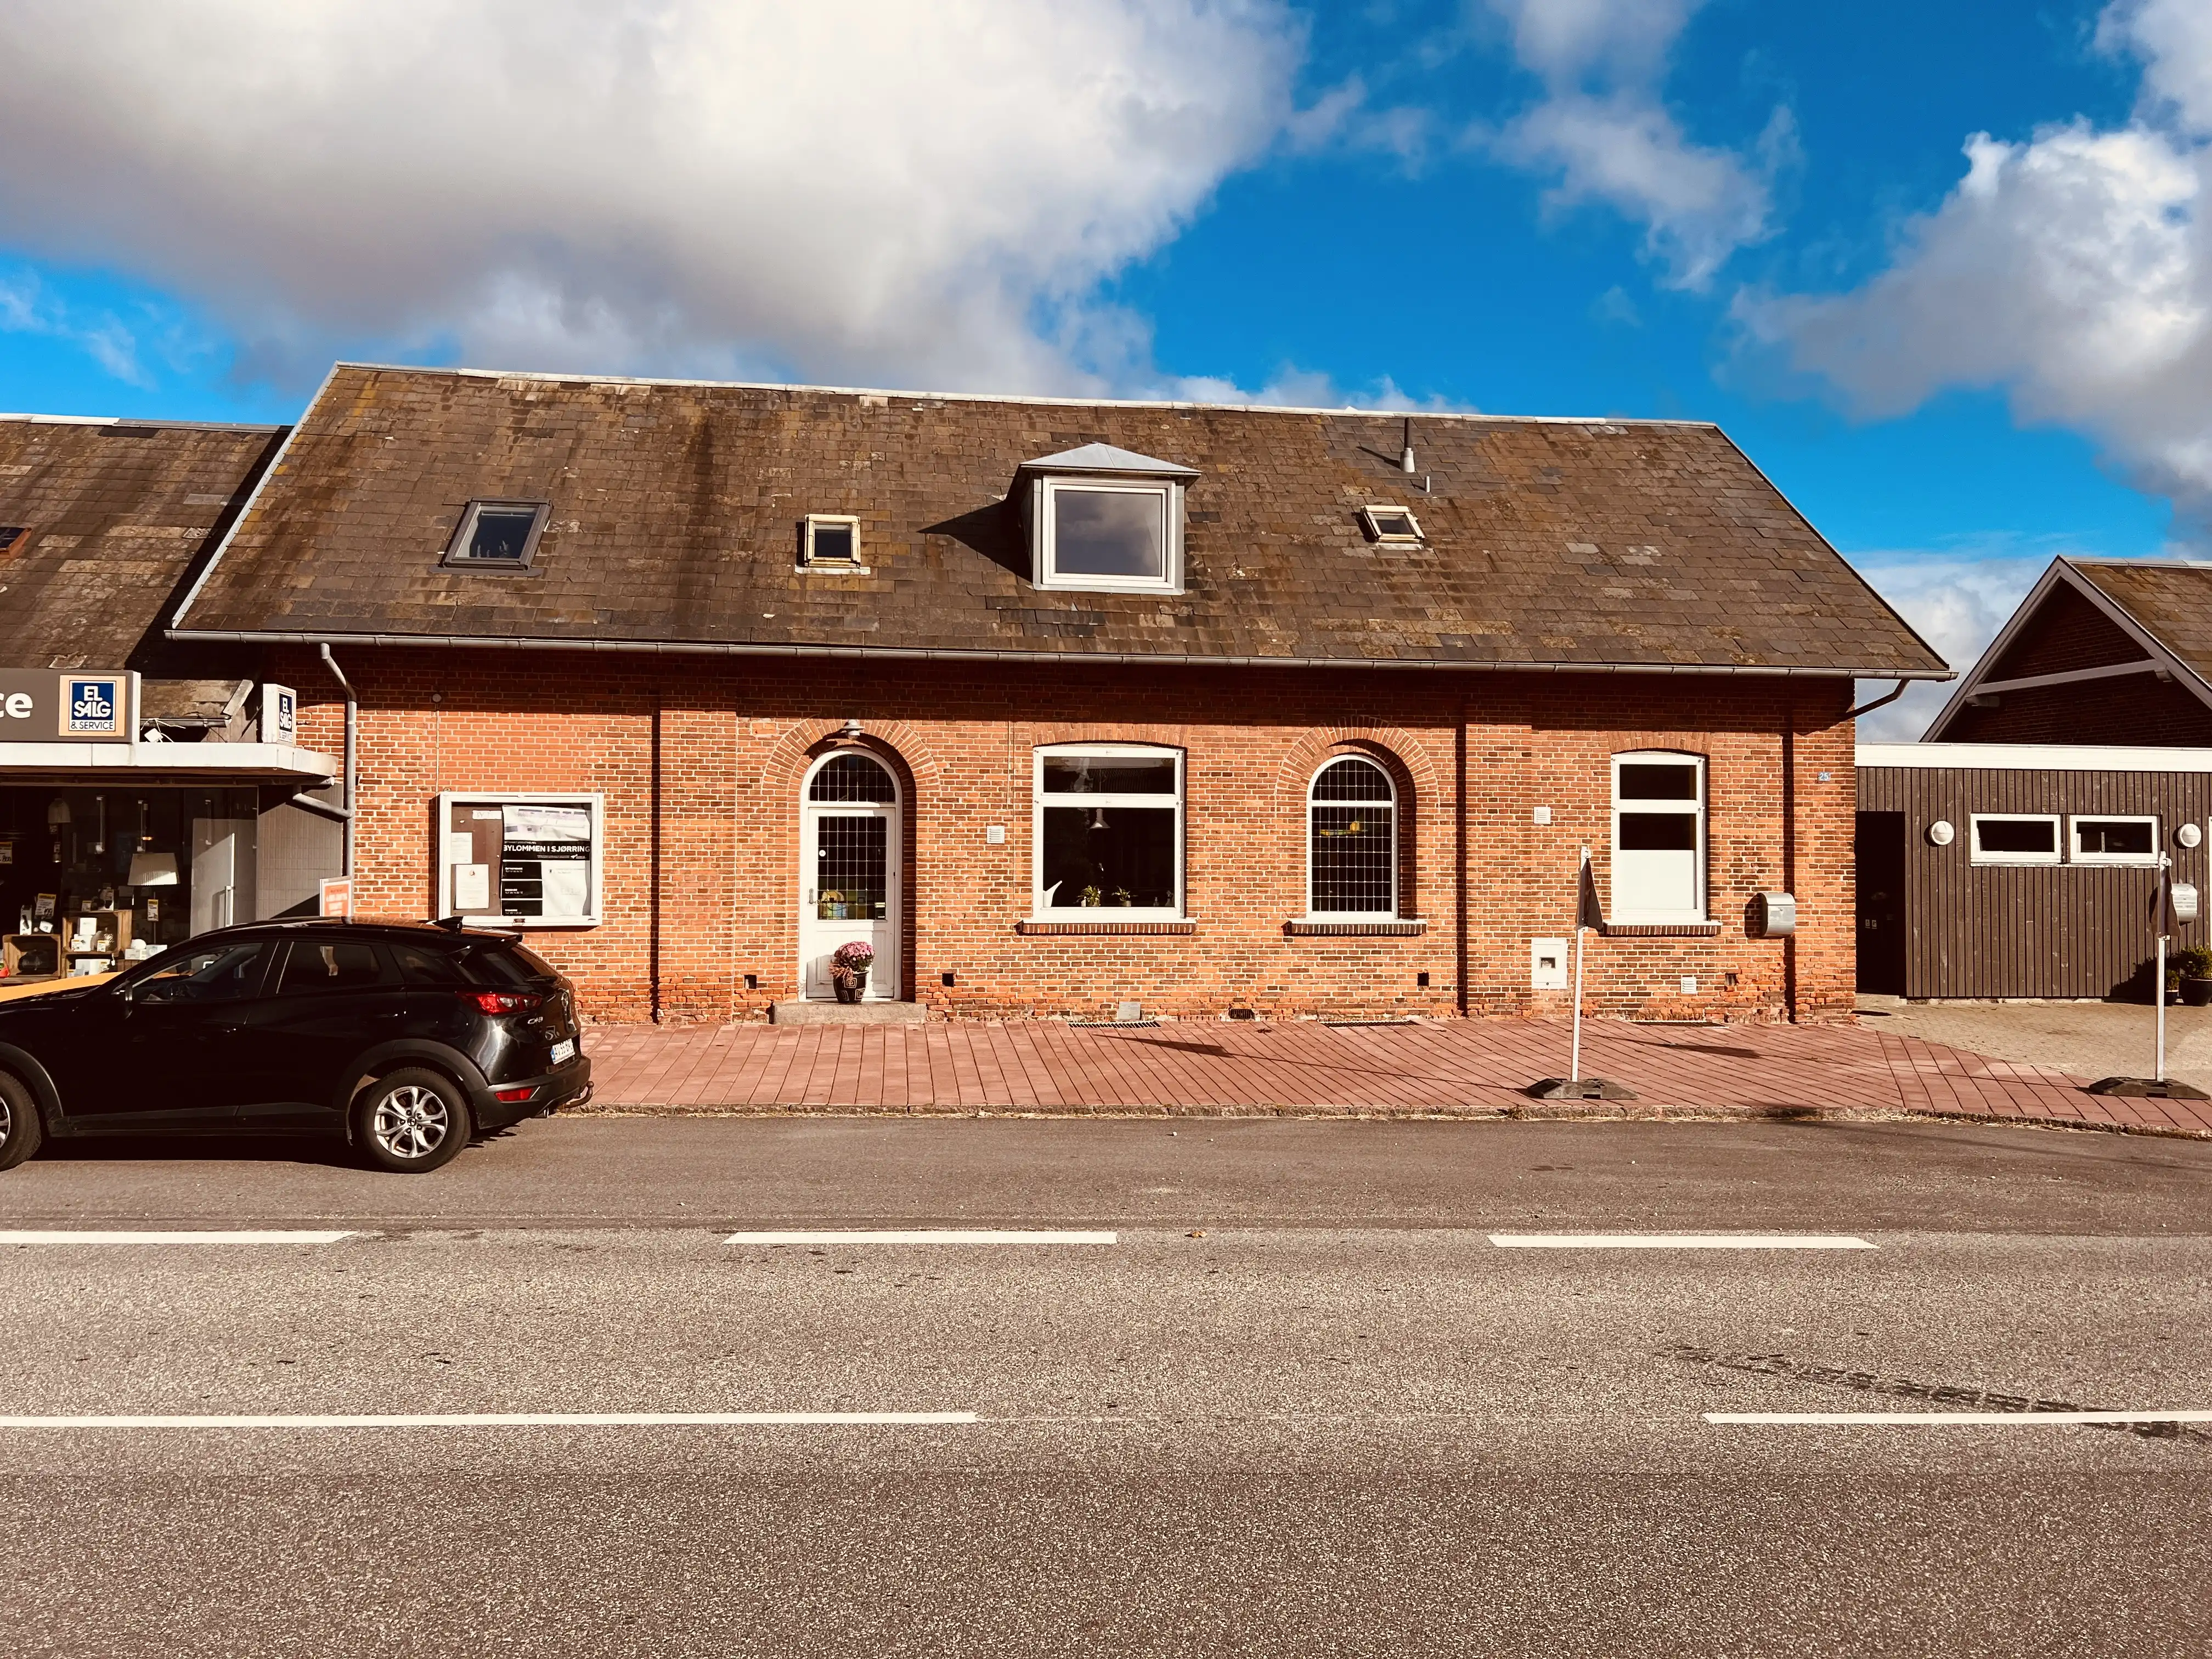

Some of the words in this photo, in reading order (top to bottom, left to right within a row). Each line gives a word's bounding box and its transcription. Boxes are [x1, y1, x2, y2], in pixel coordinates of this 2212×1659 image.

[84, 686, 103, 701] EL
[0, 692, 33, 719] e
[74, 701, 111, 718] SALG
[283, 697, 289, 713] EL
[79, 721, 114, 730] SERVICE
[1819, 772, 1829, 781] 25
